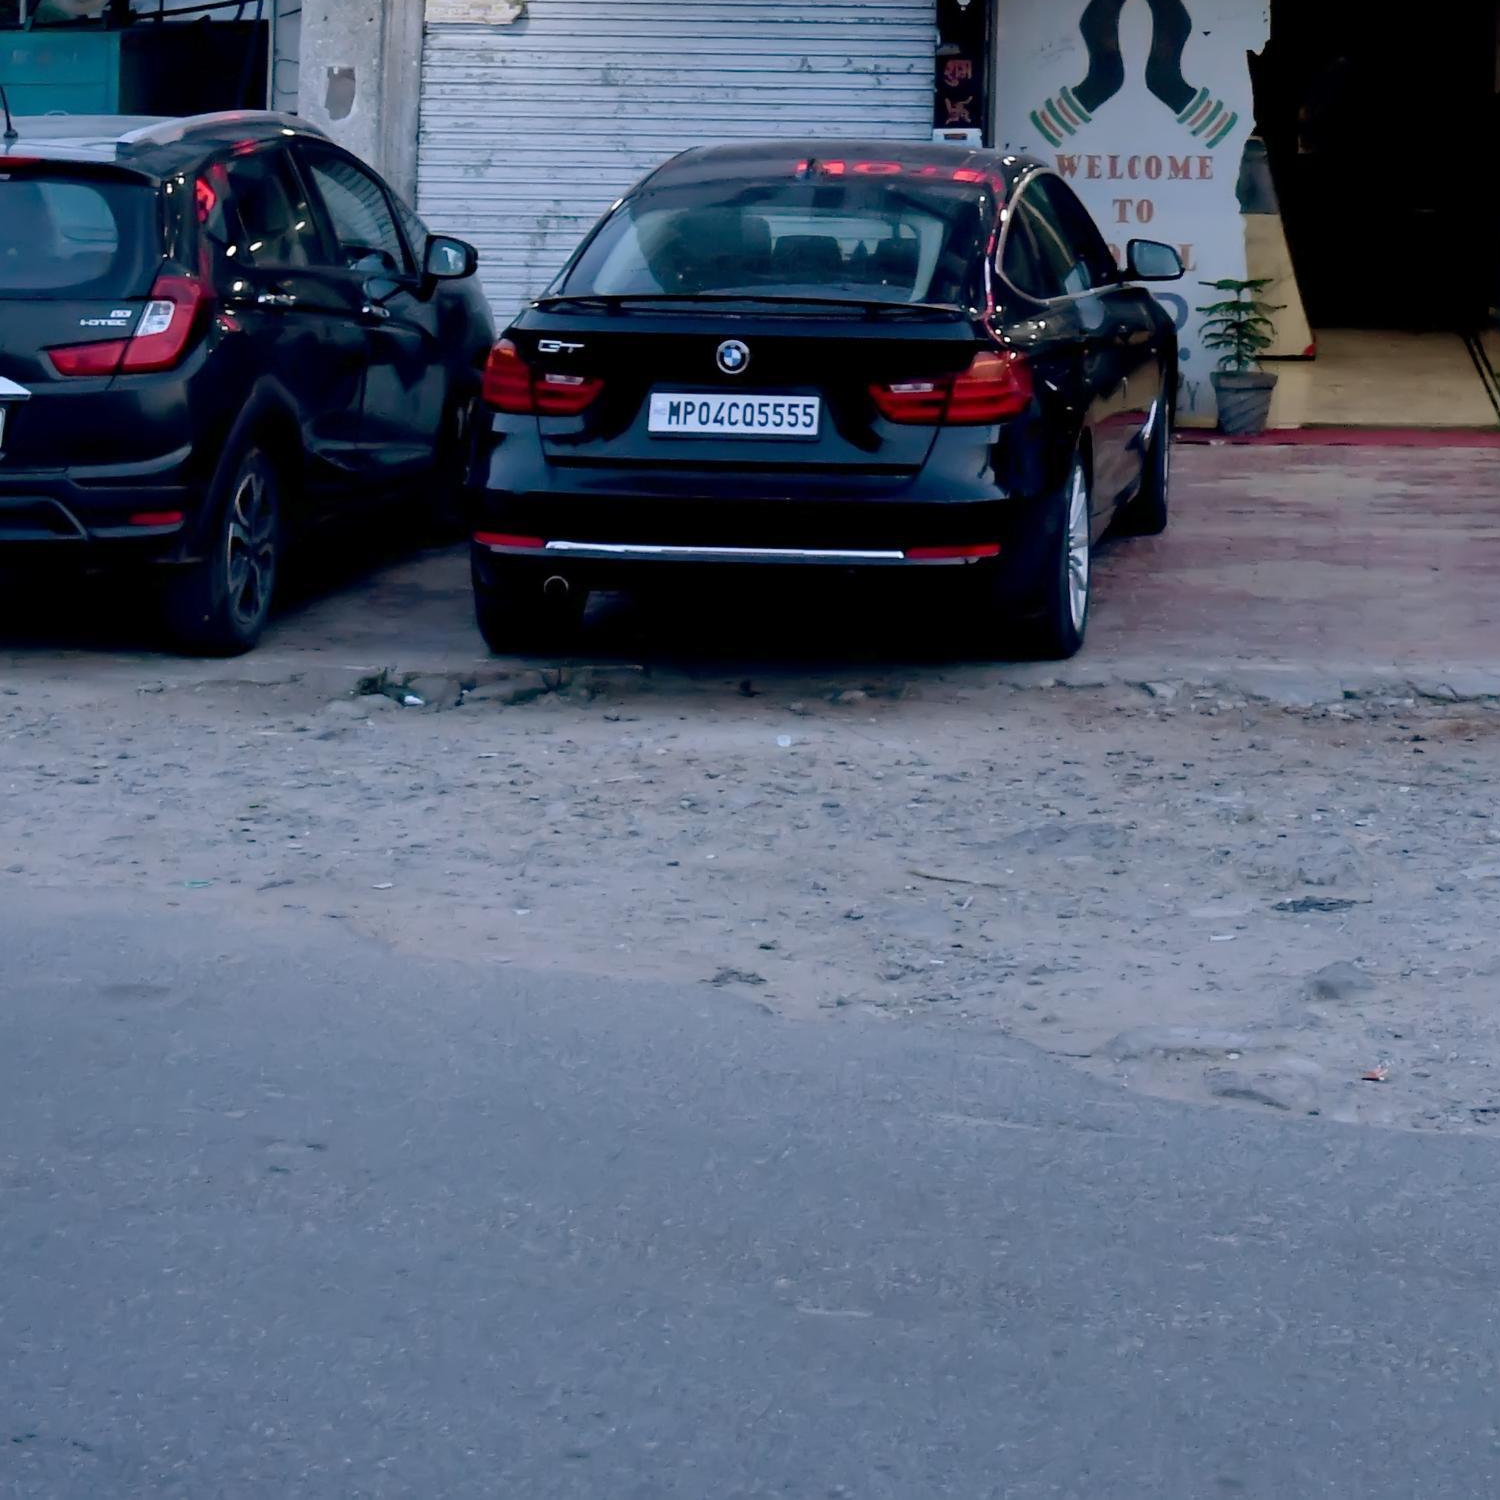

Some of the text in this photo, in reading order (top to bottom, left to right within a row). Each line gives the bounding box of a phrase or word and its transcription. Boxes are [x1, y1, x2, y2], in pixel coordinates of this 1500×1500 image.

[1054, 153, 1214, 181] WELCOME
[1111, 198, 1155, 224] TO
[667, 400, 816, 429] MP04CQ5555
